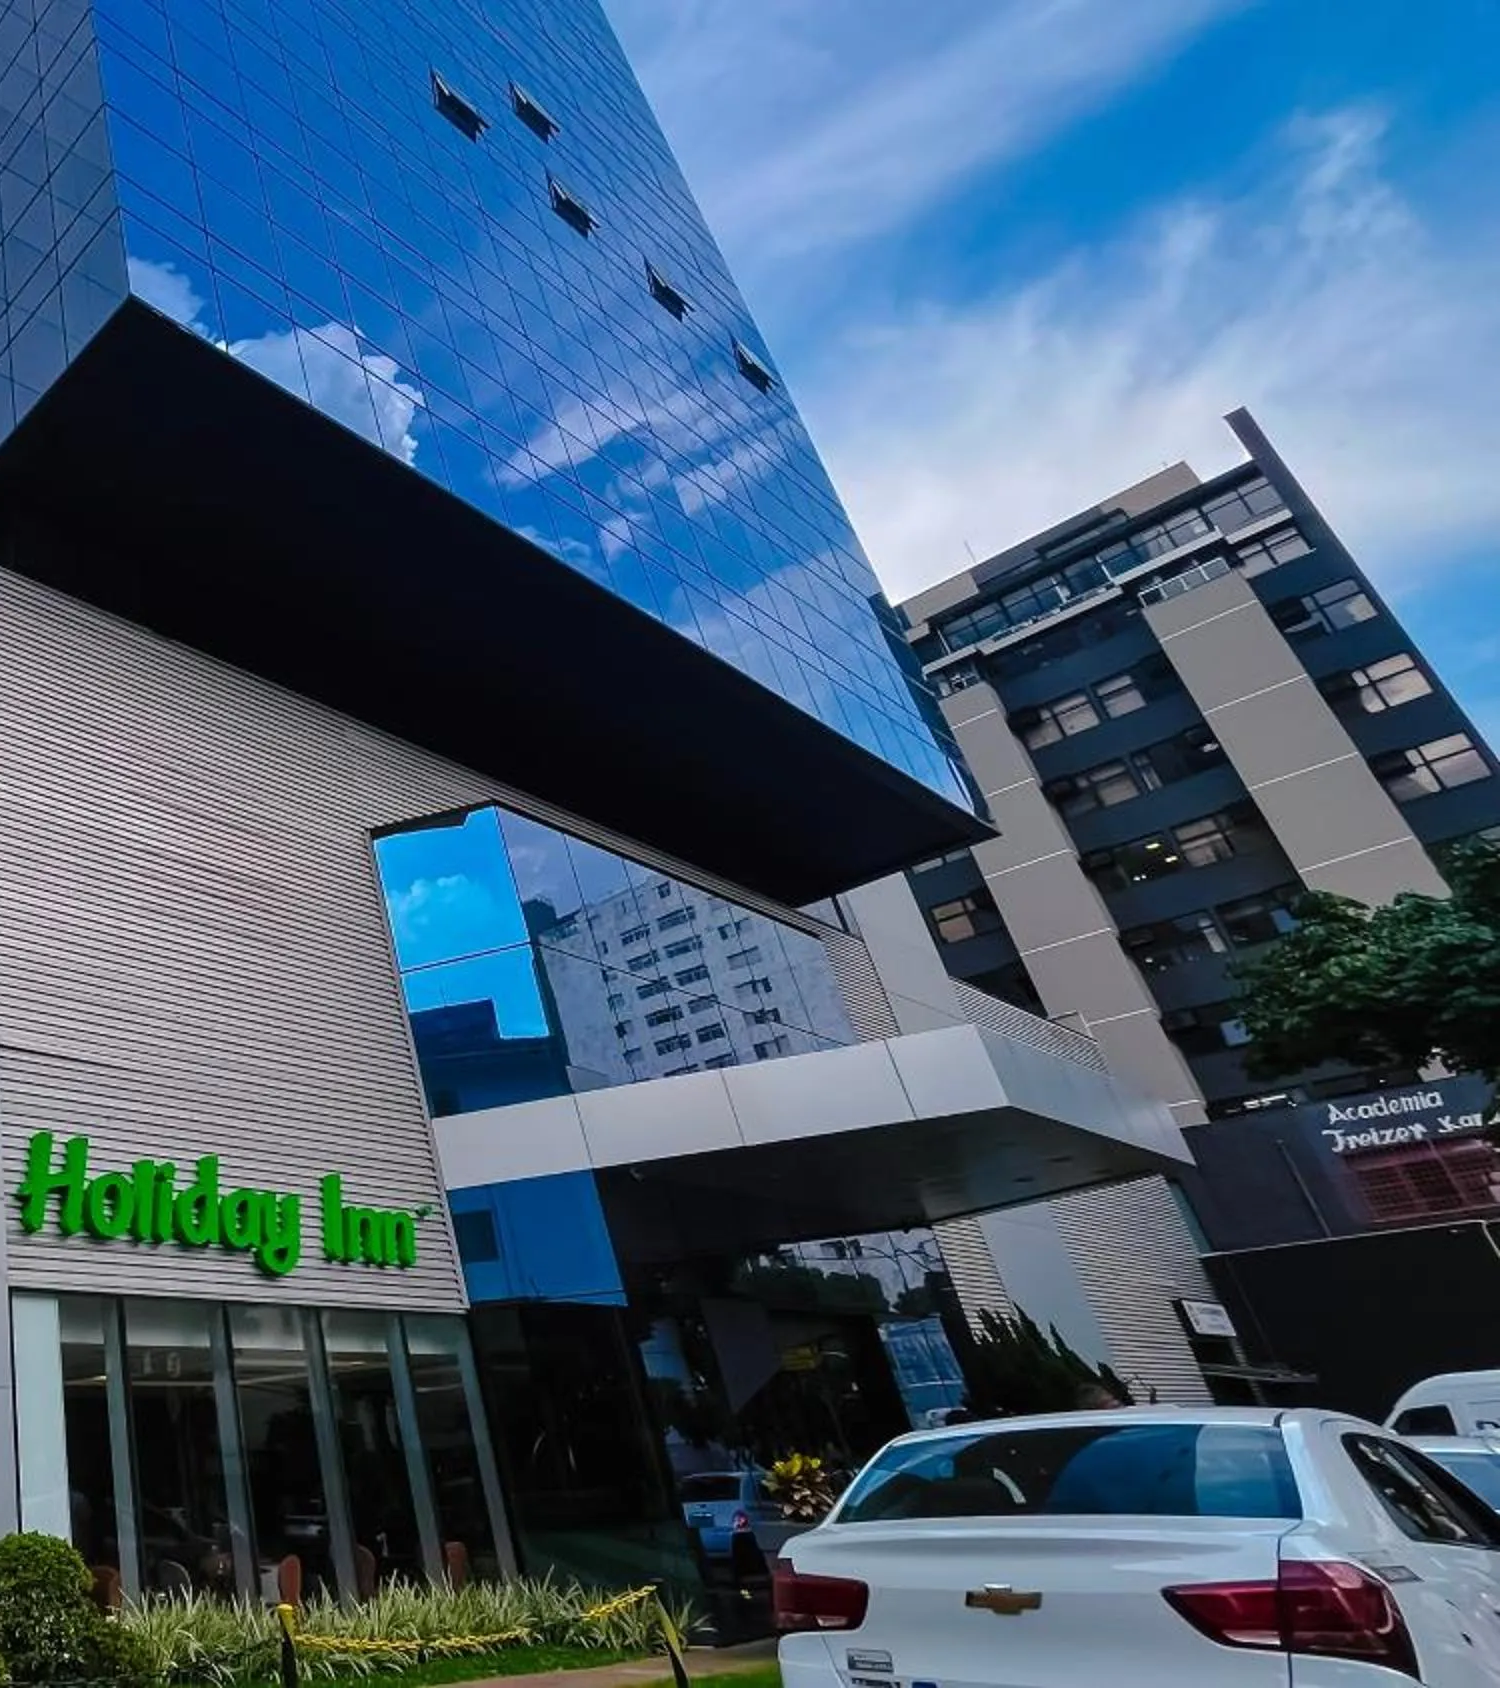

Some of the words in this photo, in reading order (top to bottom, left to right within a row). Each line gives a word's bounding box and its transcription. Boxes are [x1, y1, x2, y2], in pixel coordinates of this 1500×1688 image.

[1327, 1090, 1444, 1125] Academia
[21, 1131, 299, 1276] Holiday
[320, 1173, 416, 1267] Inn
